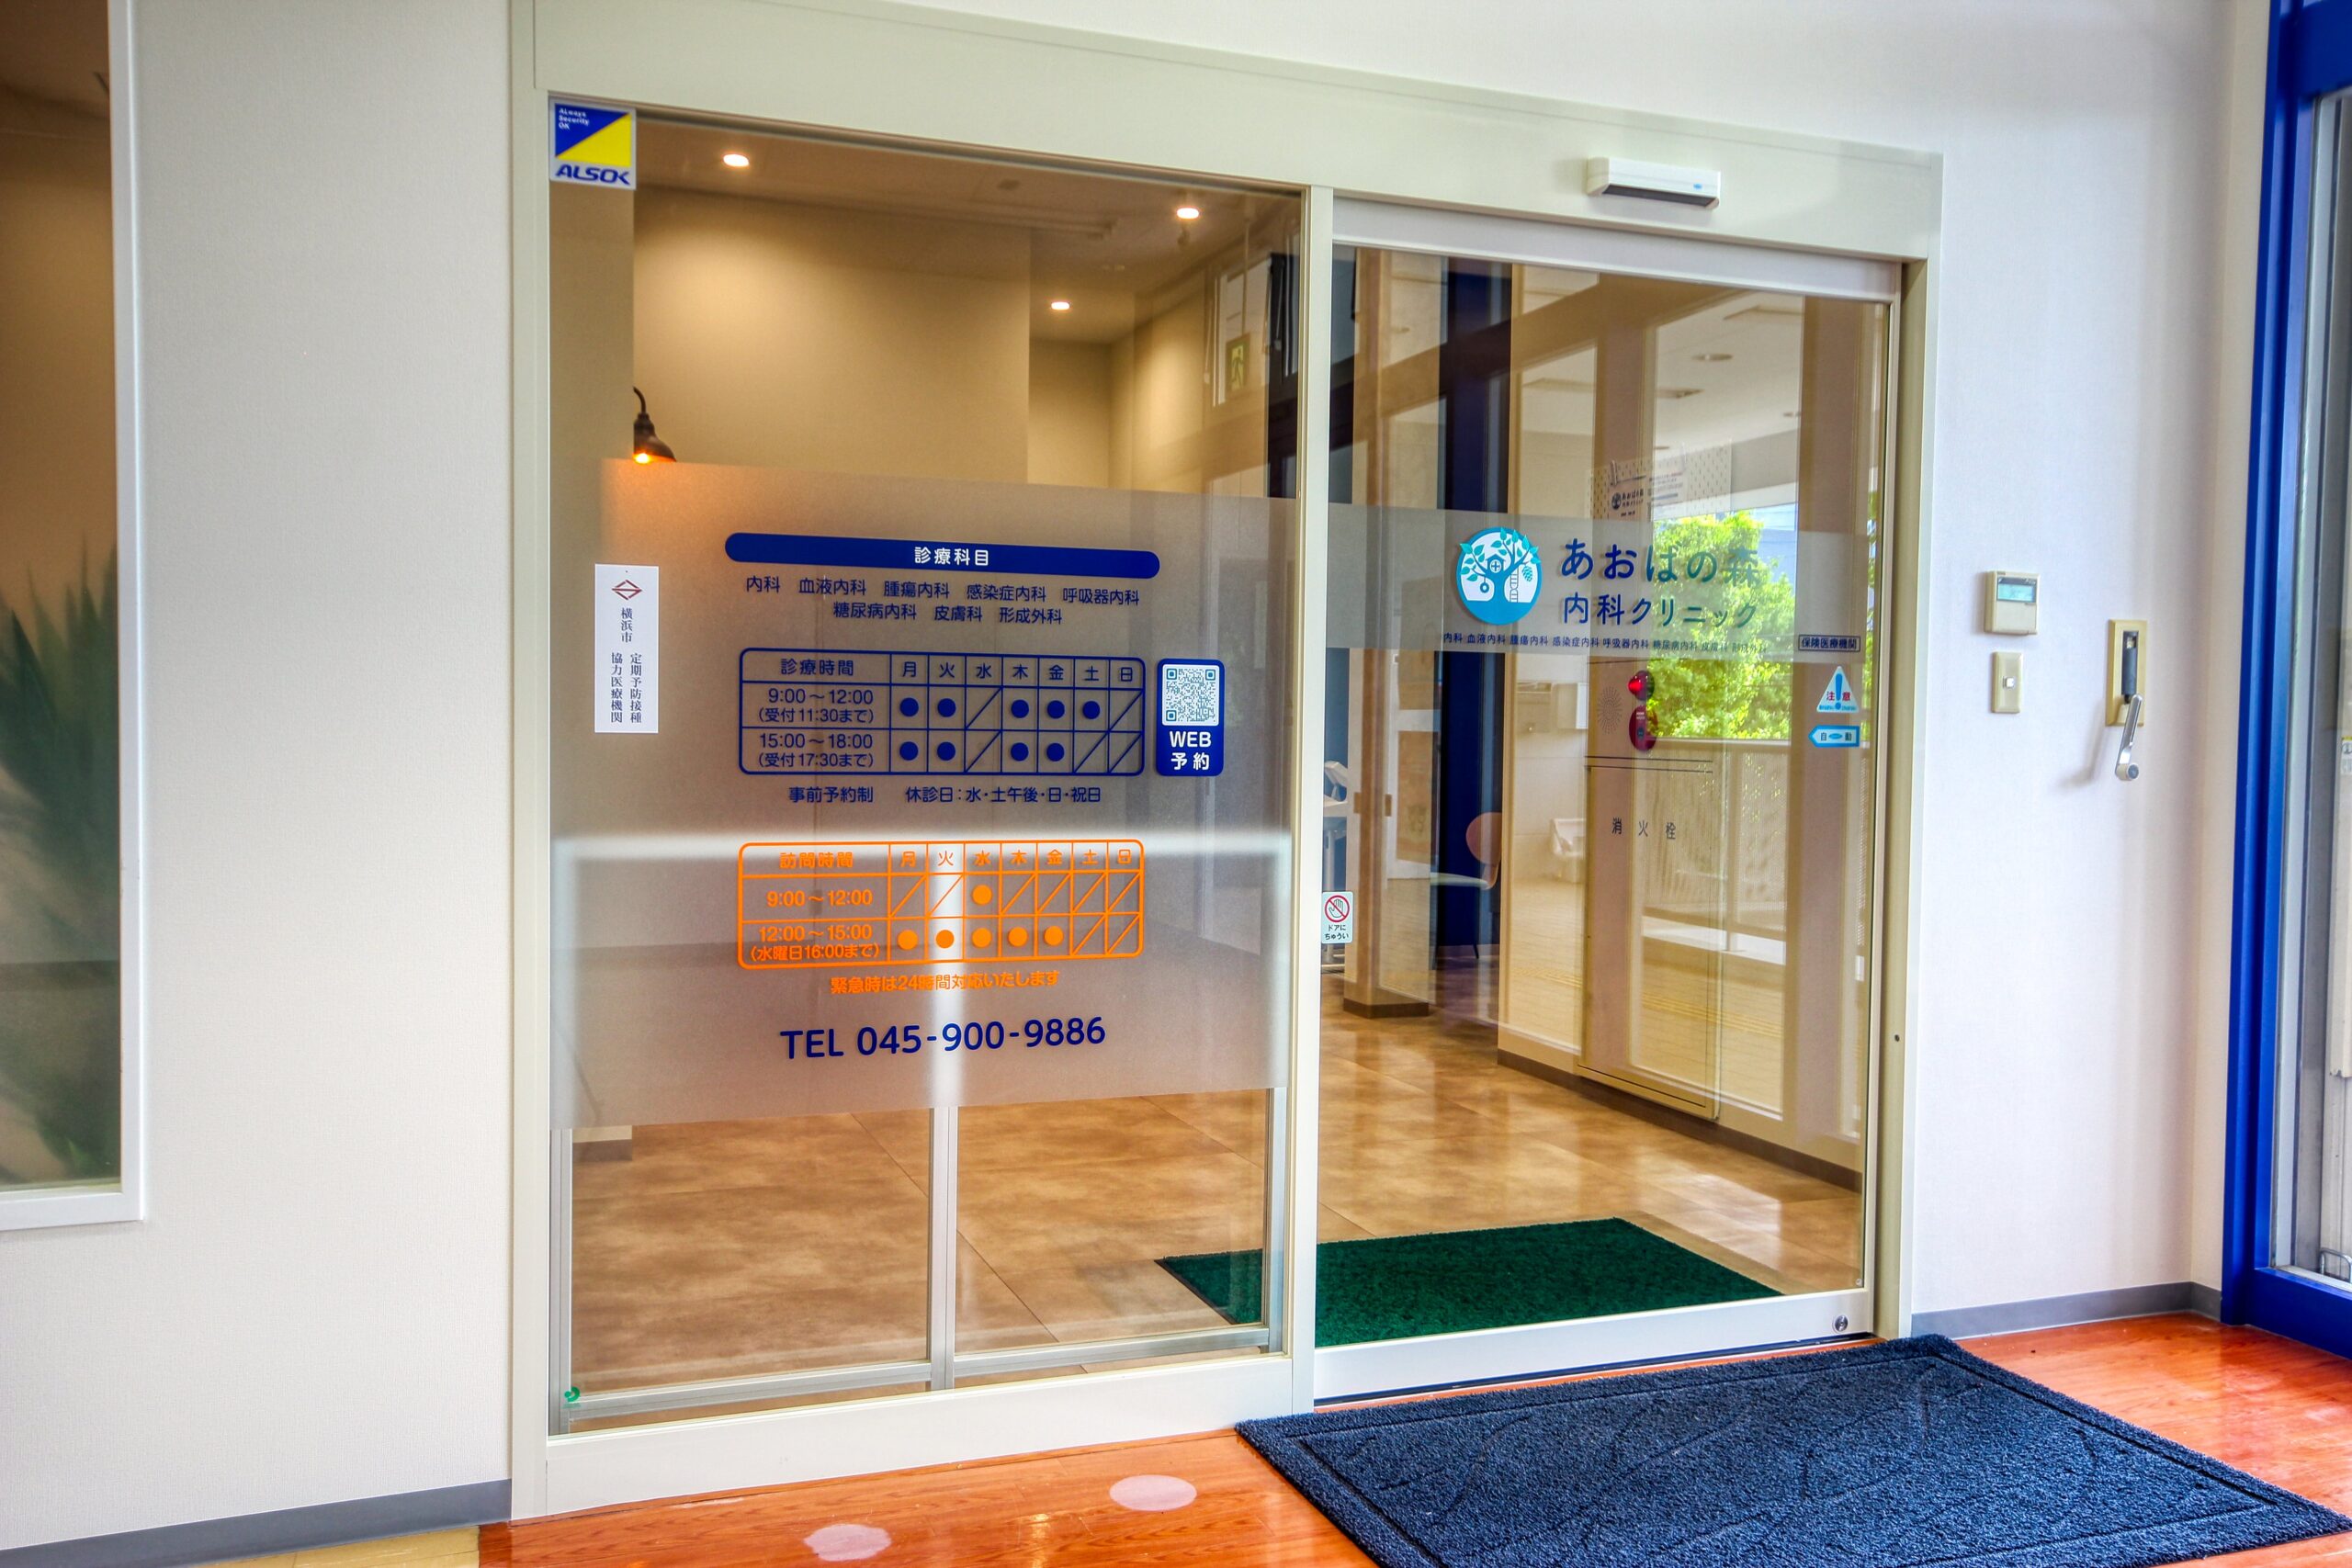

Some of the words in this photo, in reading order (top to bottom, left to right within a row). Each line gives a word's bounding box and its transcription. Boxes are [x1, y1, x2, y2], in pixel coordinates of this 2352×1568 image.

[555, 164, 630, 186] ALSOK
[914, 547, 989, 566] 診療科目
[1561, 537, 1762, 589] あおばの森
[746, 575, 780, 593] 内科
[798, 578, 866, 596] 血液内科
[884, 580, 949, 599] 腫瘍内科
[967, 583, 1046, 603] 感染症内科
[1063, 587, 1139, 606] 呼吸器内科
[833, 601, 917, 620] 糖尿病内科
[934, 604, 982, 623] 皮膚科
[999, 606, 1062, 625] 形成外科
[1564, 592, 1758, 629] 内科クリニック
[621, 606, 633, 643] 横浜市
[1443, 632, 1463, 644] 内科
[1467, 633, 1506, 645] 血液内科
[1801, 637, 1858, 649] 保険医療機関
[780, 659, 854, 676] 診療時間
[902, 661, 916, 678] 月
[939, 661, 955, 678] 火
[976, 663, 991, 678] 水
[1012, 663, 1028, 679] 木
[1049, 664, 1064, 681] 金
[1084, 665, 1099, 682] 土
[1120, 667, 1133, 682] 日
[611, 652, 623, 723] 協力医療機関
[630, 652, 642, 723] 定期予防接種
[1169, 730, 1212, 748] WEB
[1170, 751, 1210, 771] 予約
[788, 785, 873, 804] 事前予約制
[779, 852, 854, 869] 訪問時間
[900, 851, 916, 867] 月
[938, 850, 954, 866] 火
[975, 850, 990, 866] 水
[1011, 850, 1027, 865] 木
[1047, 849, 1063, 865] 金
[1082, 849, 1098, 865] 土
[1118, 849, 1131, 864] 日
[1324, 932, 1349, 941] ちゅうい
[830, 970, 1060, 995] 緊急時は24時間対応いたします
[780, 1028, 843, 1060] TEL
[856, 1016, 1107, 1055] 045-900-9886
